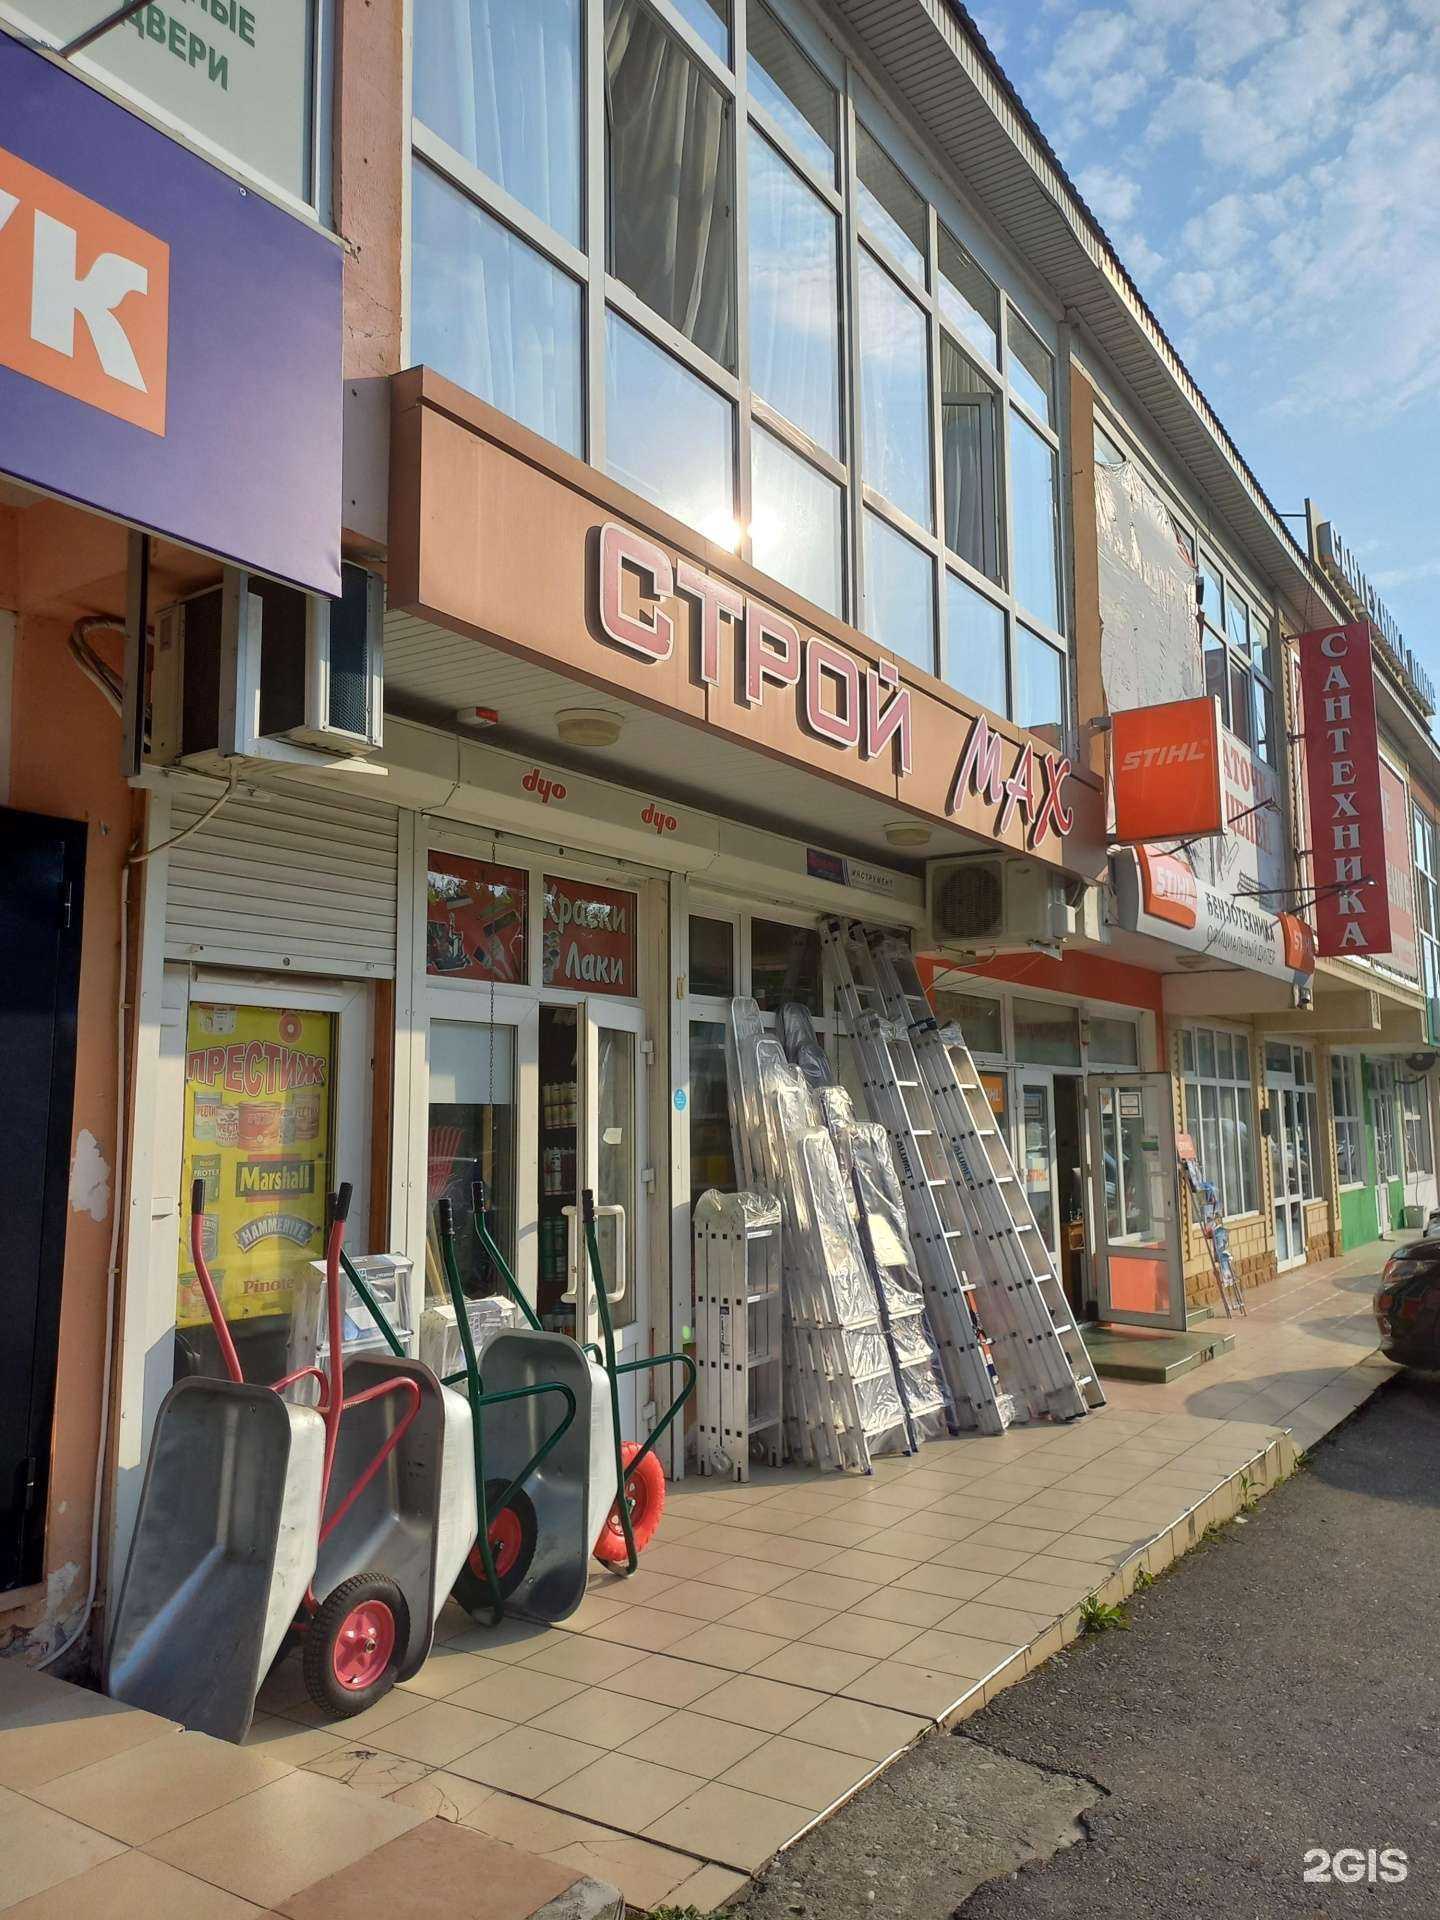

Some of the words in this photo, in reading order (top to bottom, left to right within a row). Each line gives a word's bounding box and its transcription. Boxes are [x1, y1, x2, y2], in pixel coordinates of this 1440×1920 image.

[598, 521, 913, 775] СТРОЙ
[1121, 740, 1206, 772] STIHL
[522, 768, 567, 802] dyo
[1321, 632, 1369, 948] САНТЕХНИКА
[641, 803, 678, 835] dyo
[544, 883, 627, 934] Краски
[566, 941, 624, 985] Лаки
[187, 1040, 326, 1097] ПРЕСТИЖ
[239, 1165, 310, 1192] Marshall
